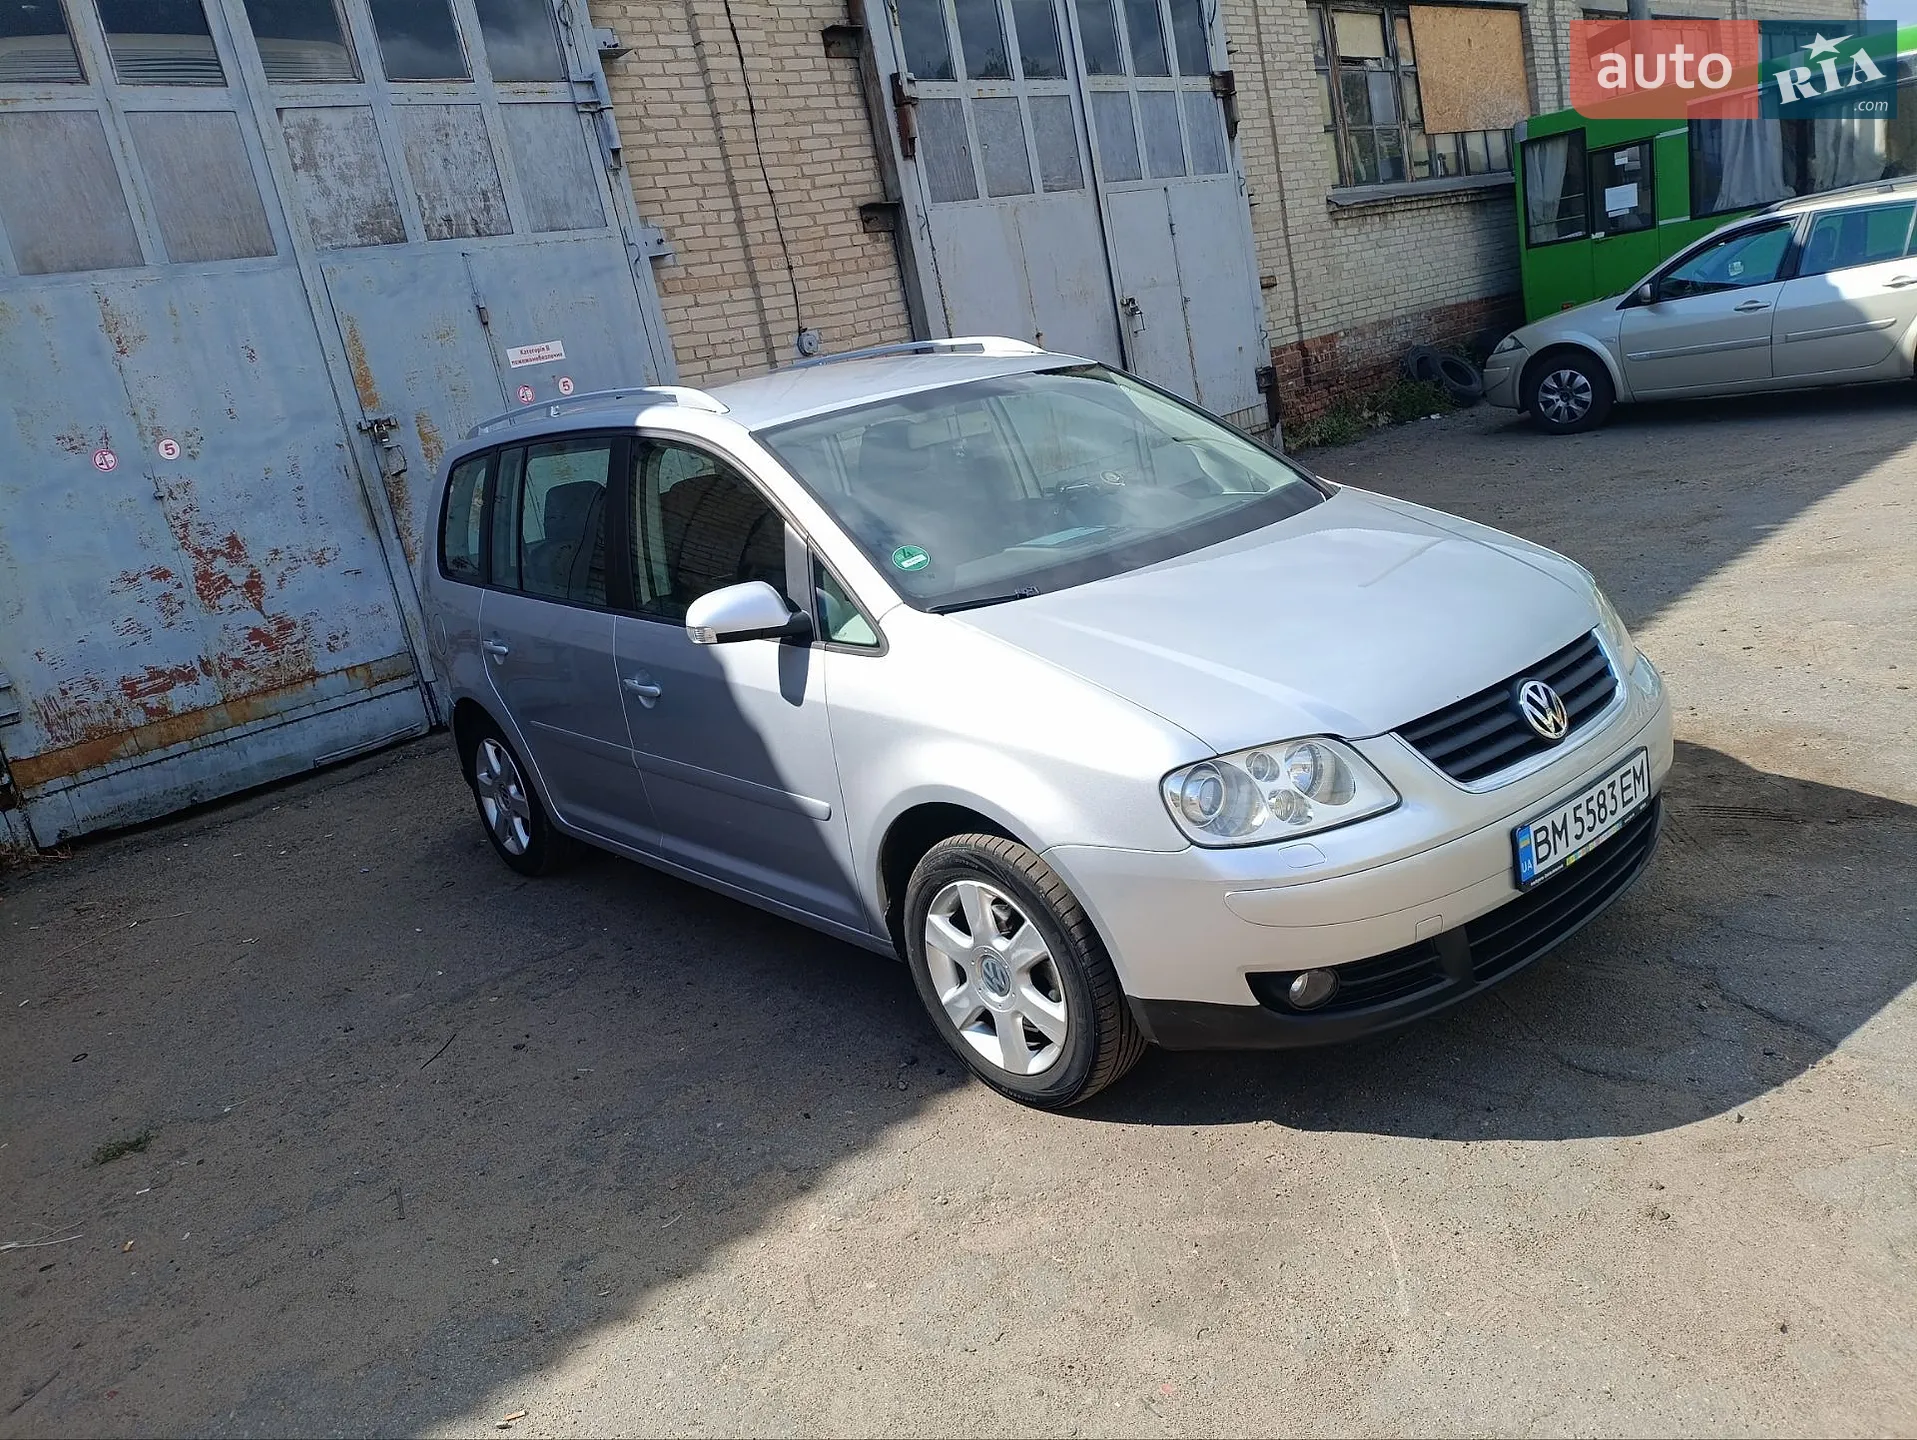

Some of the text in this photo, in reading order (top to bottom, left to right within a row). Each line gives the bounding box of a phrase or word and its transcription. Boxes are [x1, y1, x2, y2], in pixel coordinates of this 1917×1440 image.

[562, 380, 571, 391] 5
[164, 443, 176, 456] 5
[1533, 812, 1570, 866] BM
[1573, 779, 1618, 841] 5583
[1620, 758, 1646, 809] EM
[1521, 861, 1534, 873] UA
